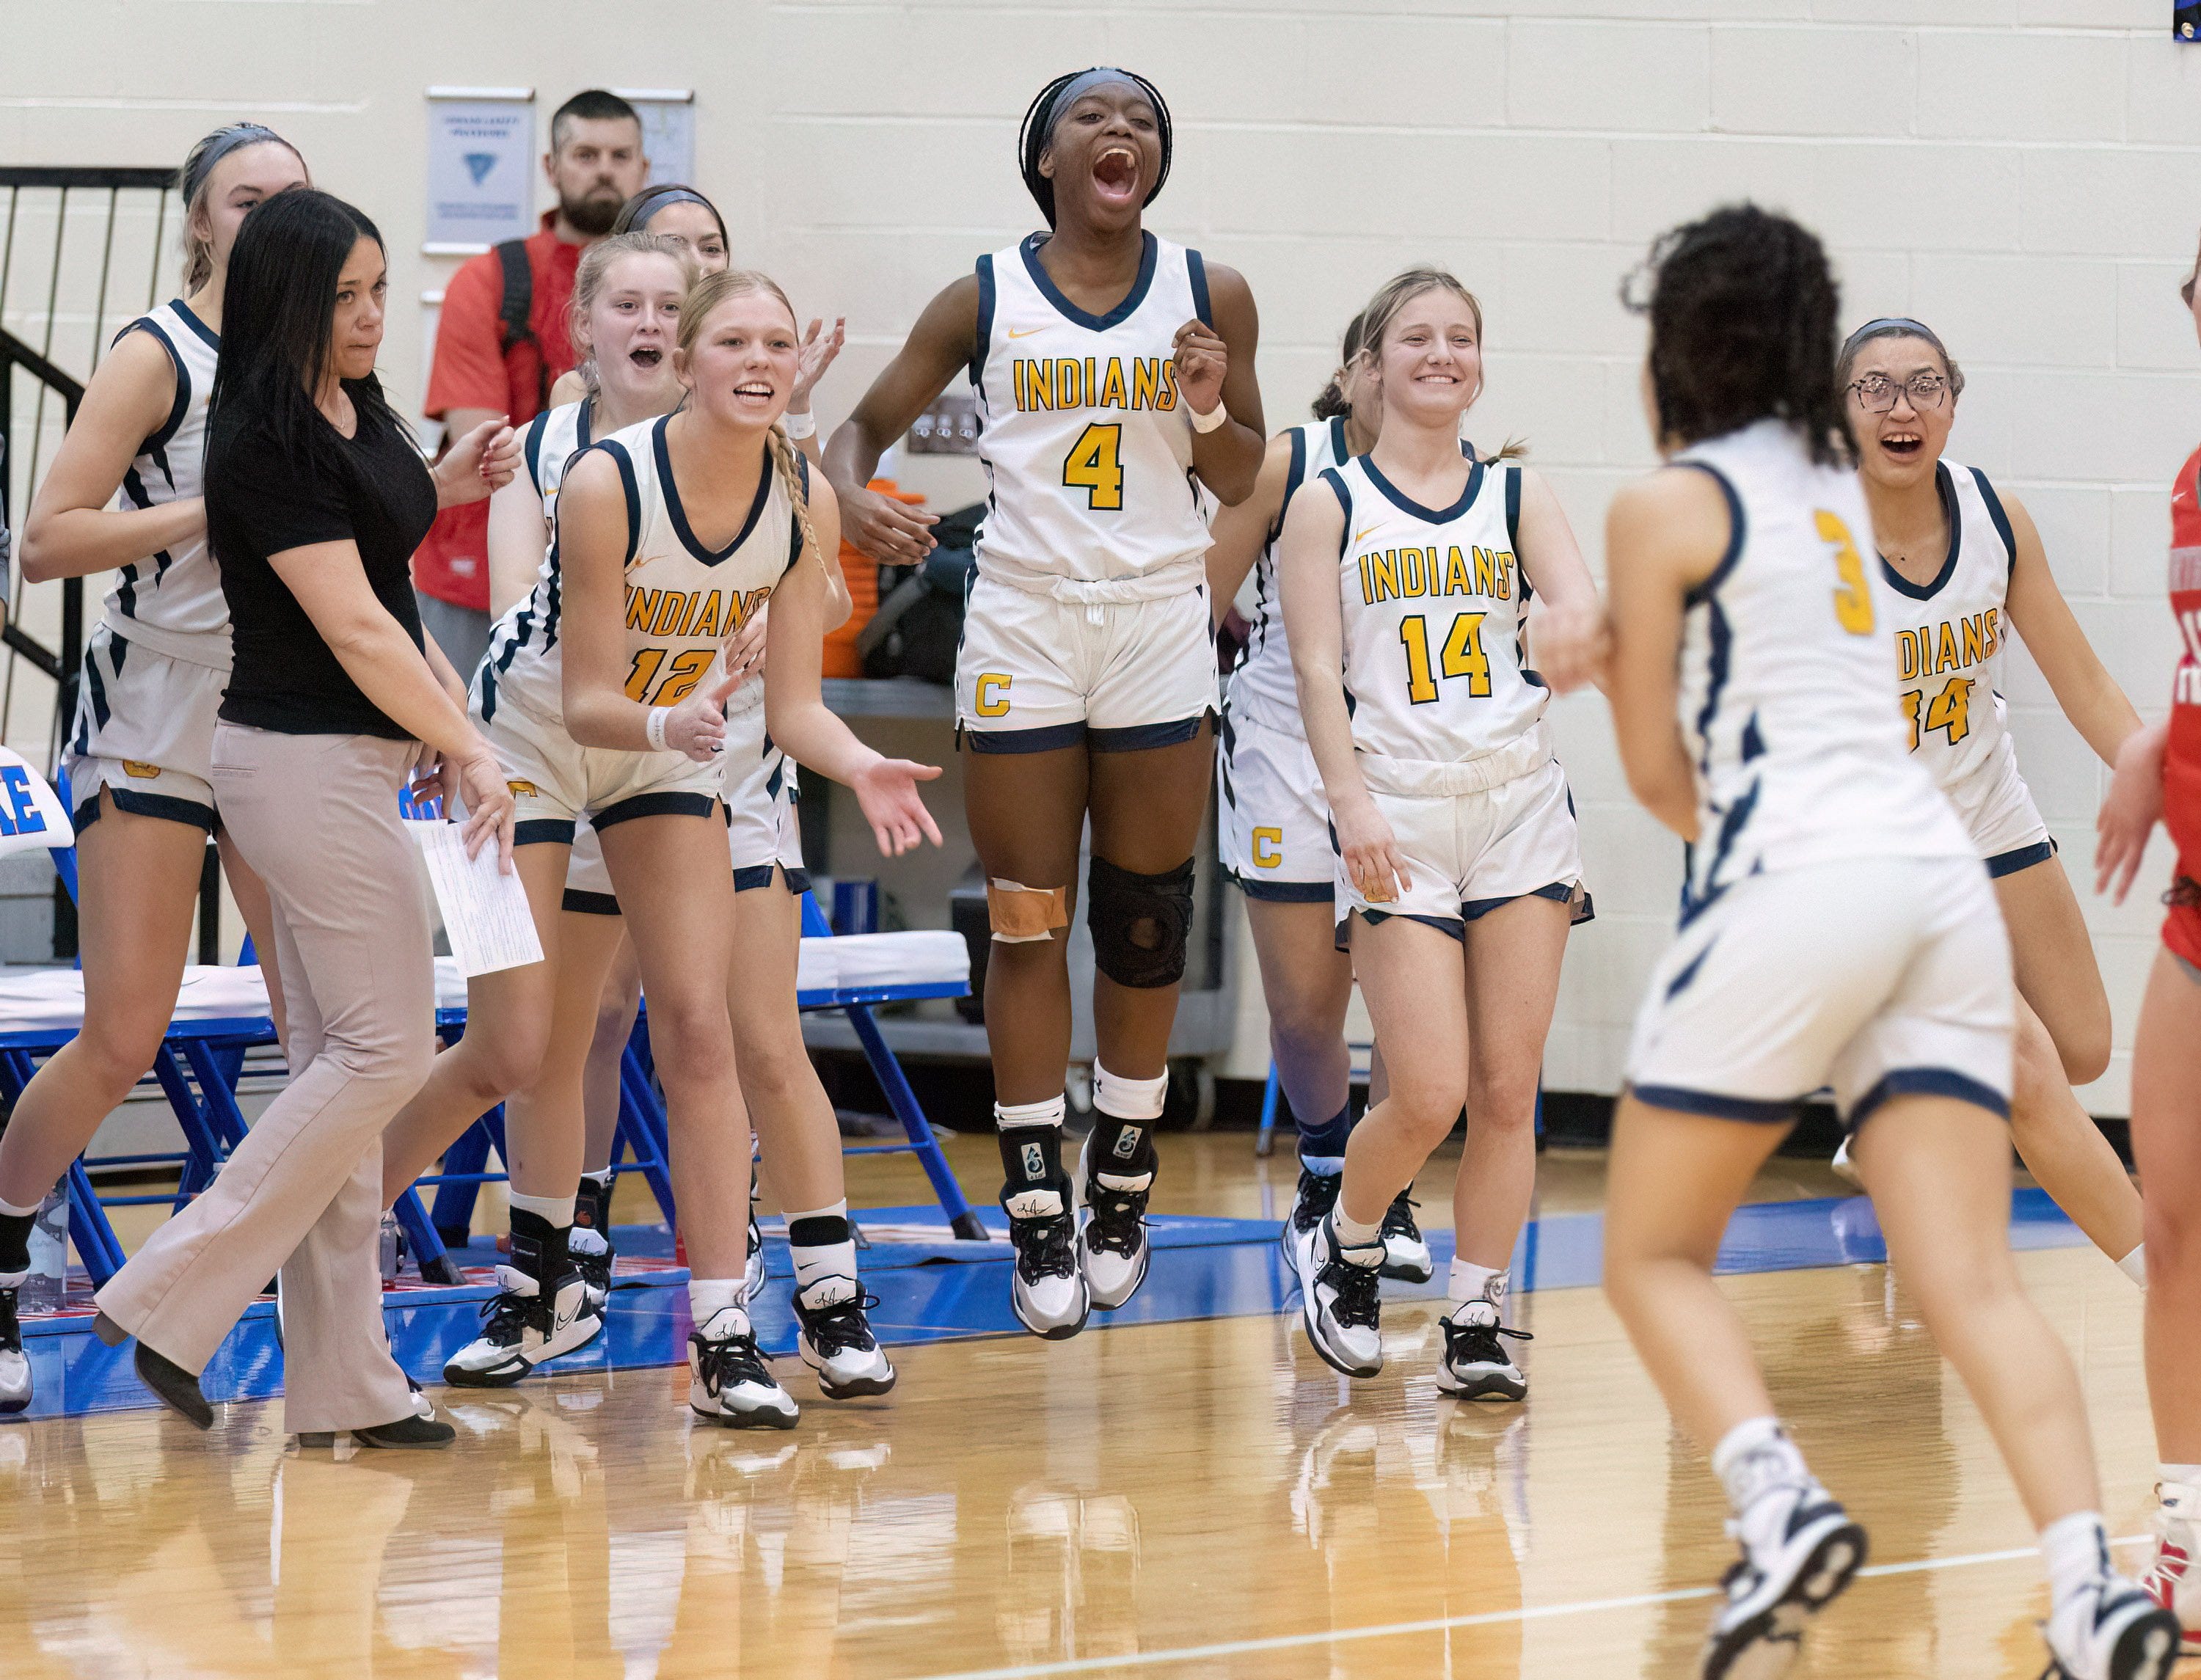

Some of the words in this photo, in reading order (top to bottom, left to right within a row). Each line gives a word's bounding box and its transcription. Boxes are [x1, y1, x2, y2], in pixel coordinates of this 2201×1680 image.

[1013, 357, 1178, 412] INDIANS
[1062, 423, 1124, 511] 4
[1359, 545, 1514, 605] INDIANS
[1814, 509, 1875, 636] 3
[625, 586, 771, 638] NDIAN
[1399, 612, 1492, 706] 14
[1895, 607, 1999, 681] DIANS
[625, 648, 717, 708] 12
[975, 672, 1012, 717] C
[1252, 826, 1282, 869] C
